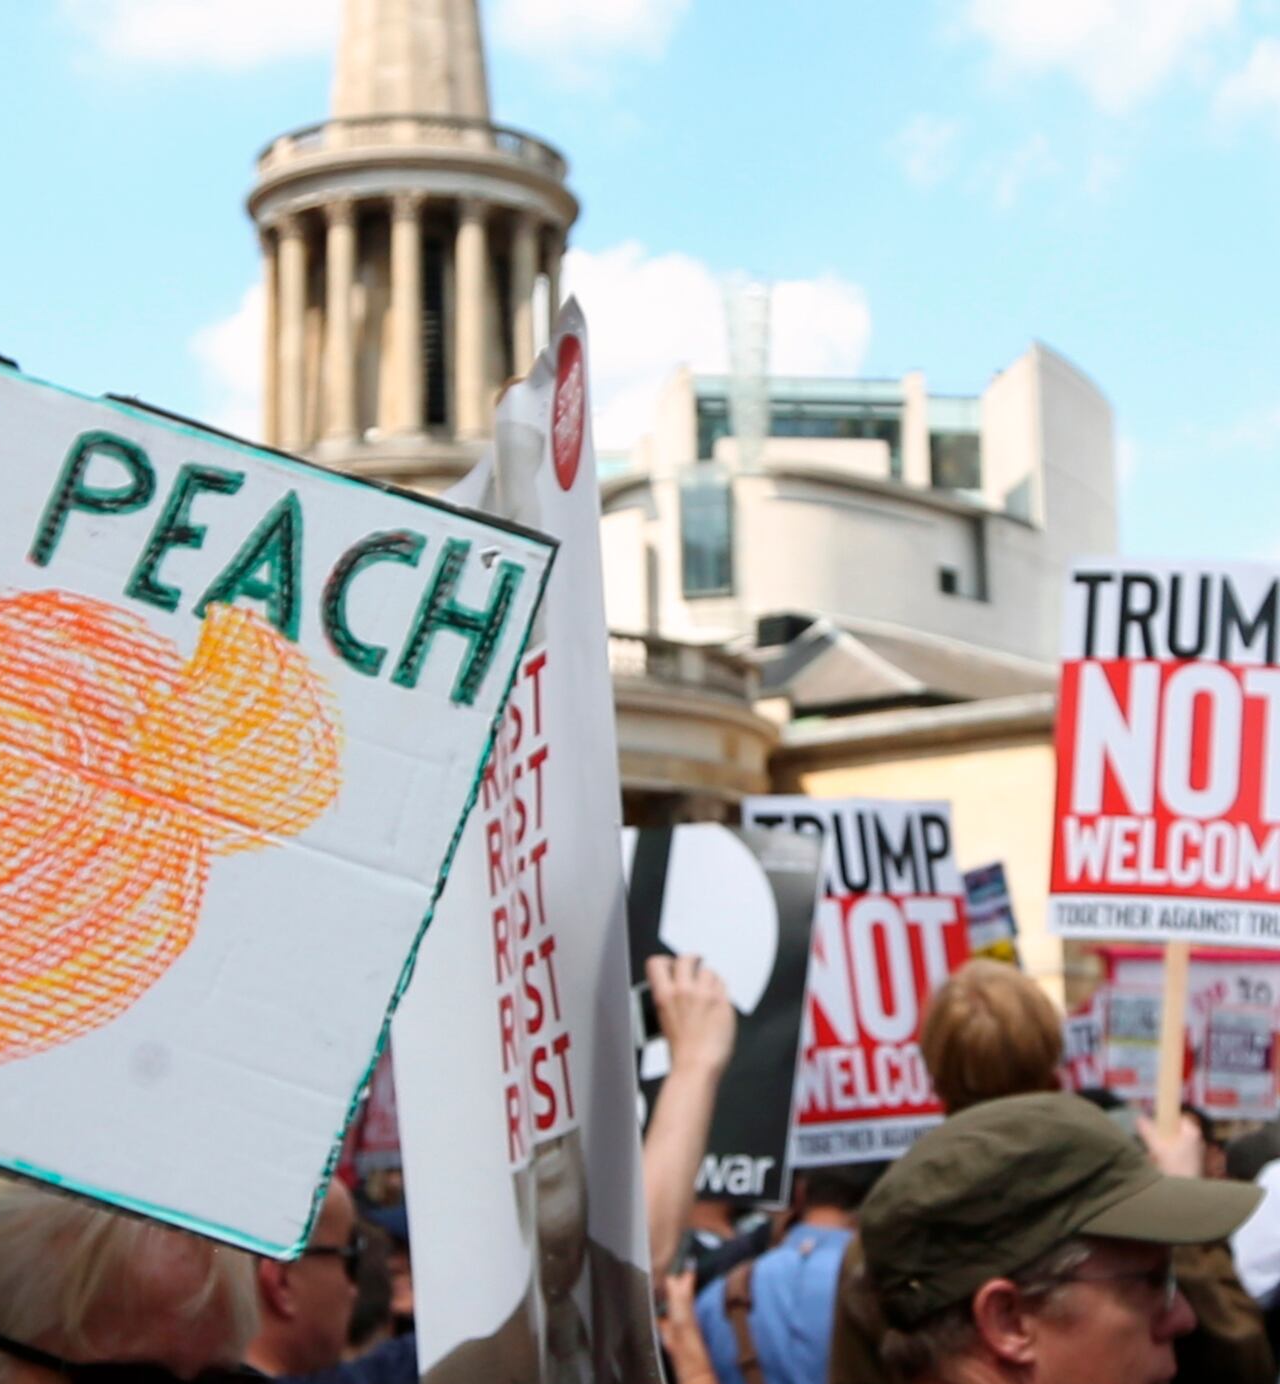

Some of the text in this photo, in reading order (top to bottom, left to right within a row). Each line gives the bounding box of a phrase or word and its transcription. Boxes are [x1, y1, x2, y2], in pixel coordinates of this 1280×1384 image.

[27, 430, 525, 707] PEACH
[806, 896, 958, 1046] NOT
[1055, 899, 1152, 928] TOGETHER
[1157, 905, 1243, 935] AGAINST
